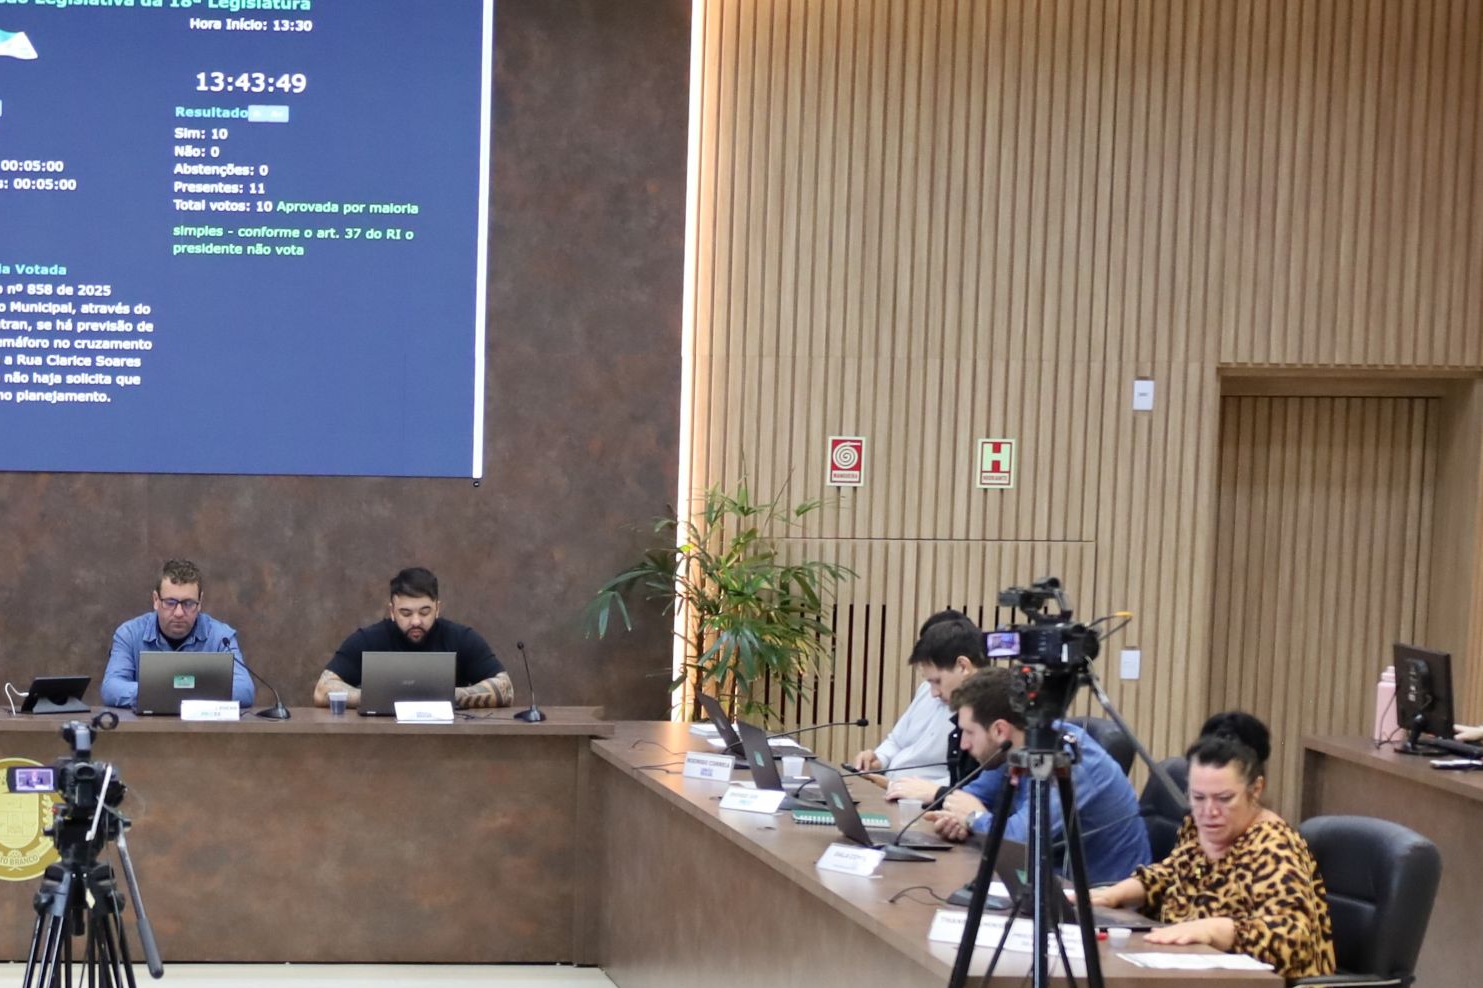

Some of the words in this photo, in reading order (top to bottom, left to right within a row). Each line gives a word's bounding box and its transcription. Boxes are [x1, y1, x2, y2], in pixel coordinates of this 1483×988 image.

[208, 0, 311, 11] Legislatura
[189, 18, 222, 30] Hora
[225, 17, 268, 31] Início:
[273, 19, 313, 31] 13:30
[196, 72, 307, 93] 13:43:49
[175, 106, 248, 118] Resultado
[174, 127, 205, 139] Sim:
[211, 128, 228, 140] 10
[174, 145, 206, 157] Não:
[210, 146, 220, 157] 0
[0, 159, 64, 172] 00:05:00
[173, 163, 254, 177] Abstenções:
[259, 165, 269, 176] 0
[13, 178, 77, 190] 00:05:00
[174, 181, 244, 193] Presentes:
[249, 183, 265, 194] 11
[173, 199, 206, 211] Total
[209, 200, 250, 212] votos:
[256, 201, 273, 212] 10
[276, 201, 339, 214] Aprovada
[343, 204, 366, 215] por
[369, 203, 419, 214] maioria
[173, 225, 224, 238] simples
[237, 226, 300, 238] conforme
[304, 229, 313, 238] o
[316, 228, 339, 238] art.
[344, 228, 362, 239] 37
[365, 228, 383, 239] do
[386, 229, 401, 240] RI
[405, 231, 414, 240] o
[173, 243, 243, 255] presidente
[247, 243, 272, 255] não
[275, 245, 304, 255] vota
[15, 264, 67, 275] Votada
[27, 283, 53, 295] 858
[56, 284, 74, 295] de
[77, 284, 111, 296] 2025
[10, 301, 76, 315] Municipal,
[80, 302, 130, 314] através
[133, 303, 151, 315] do
[36, 321, 52, 330] se
[56, 318, 73, 331] há
[77, 319, 133, 333] previsão
[136, 321, 154, 332] de
[53, 339, 71, 349] no
[74, 339, 153, 350] cruzamento
[4, 356, 13, 365] a
[16, 354, 43, 366] Rua
[46, 354, 92, 366] Clarice
[95, 355, 141, 367] Soares
[4, 371, 29, 383] não
[32, 372, 62, 386] haja
[65, 373, 112, 384] solicita
[115, 375, 141, 387] que
[16, 389, 111, 404] planejamento.
